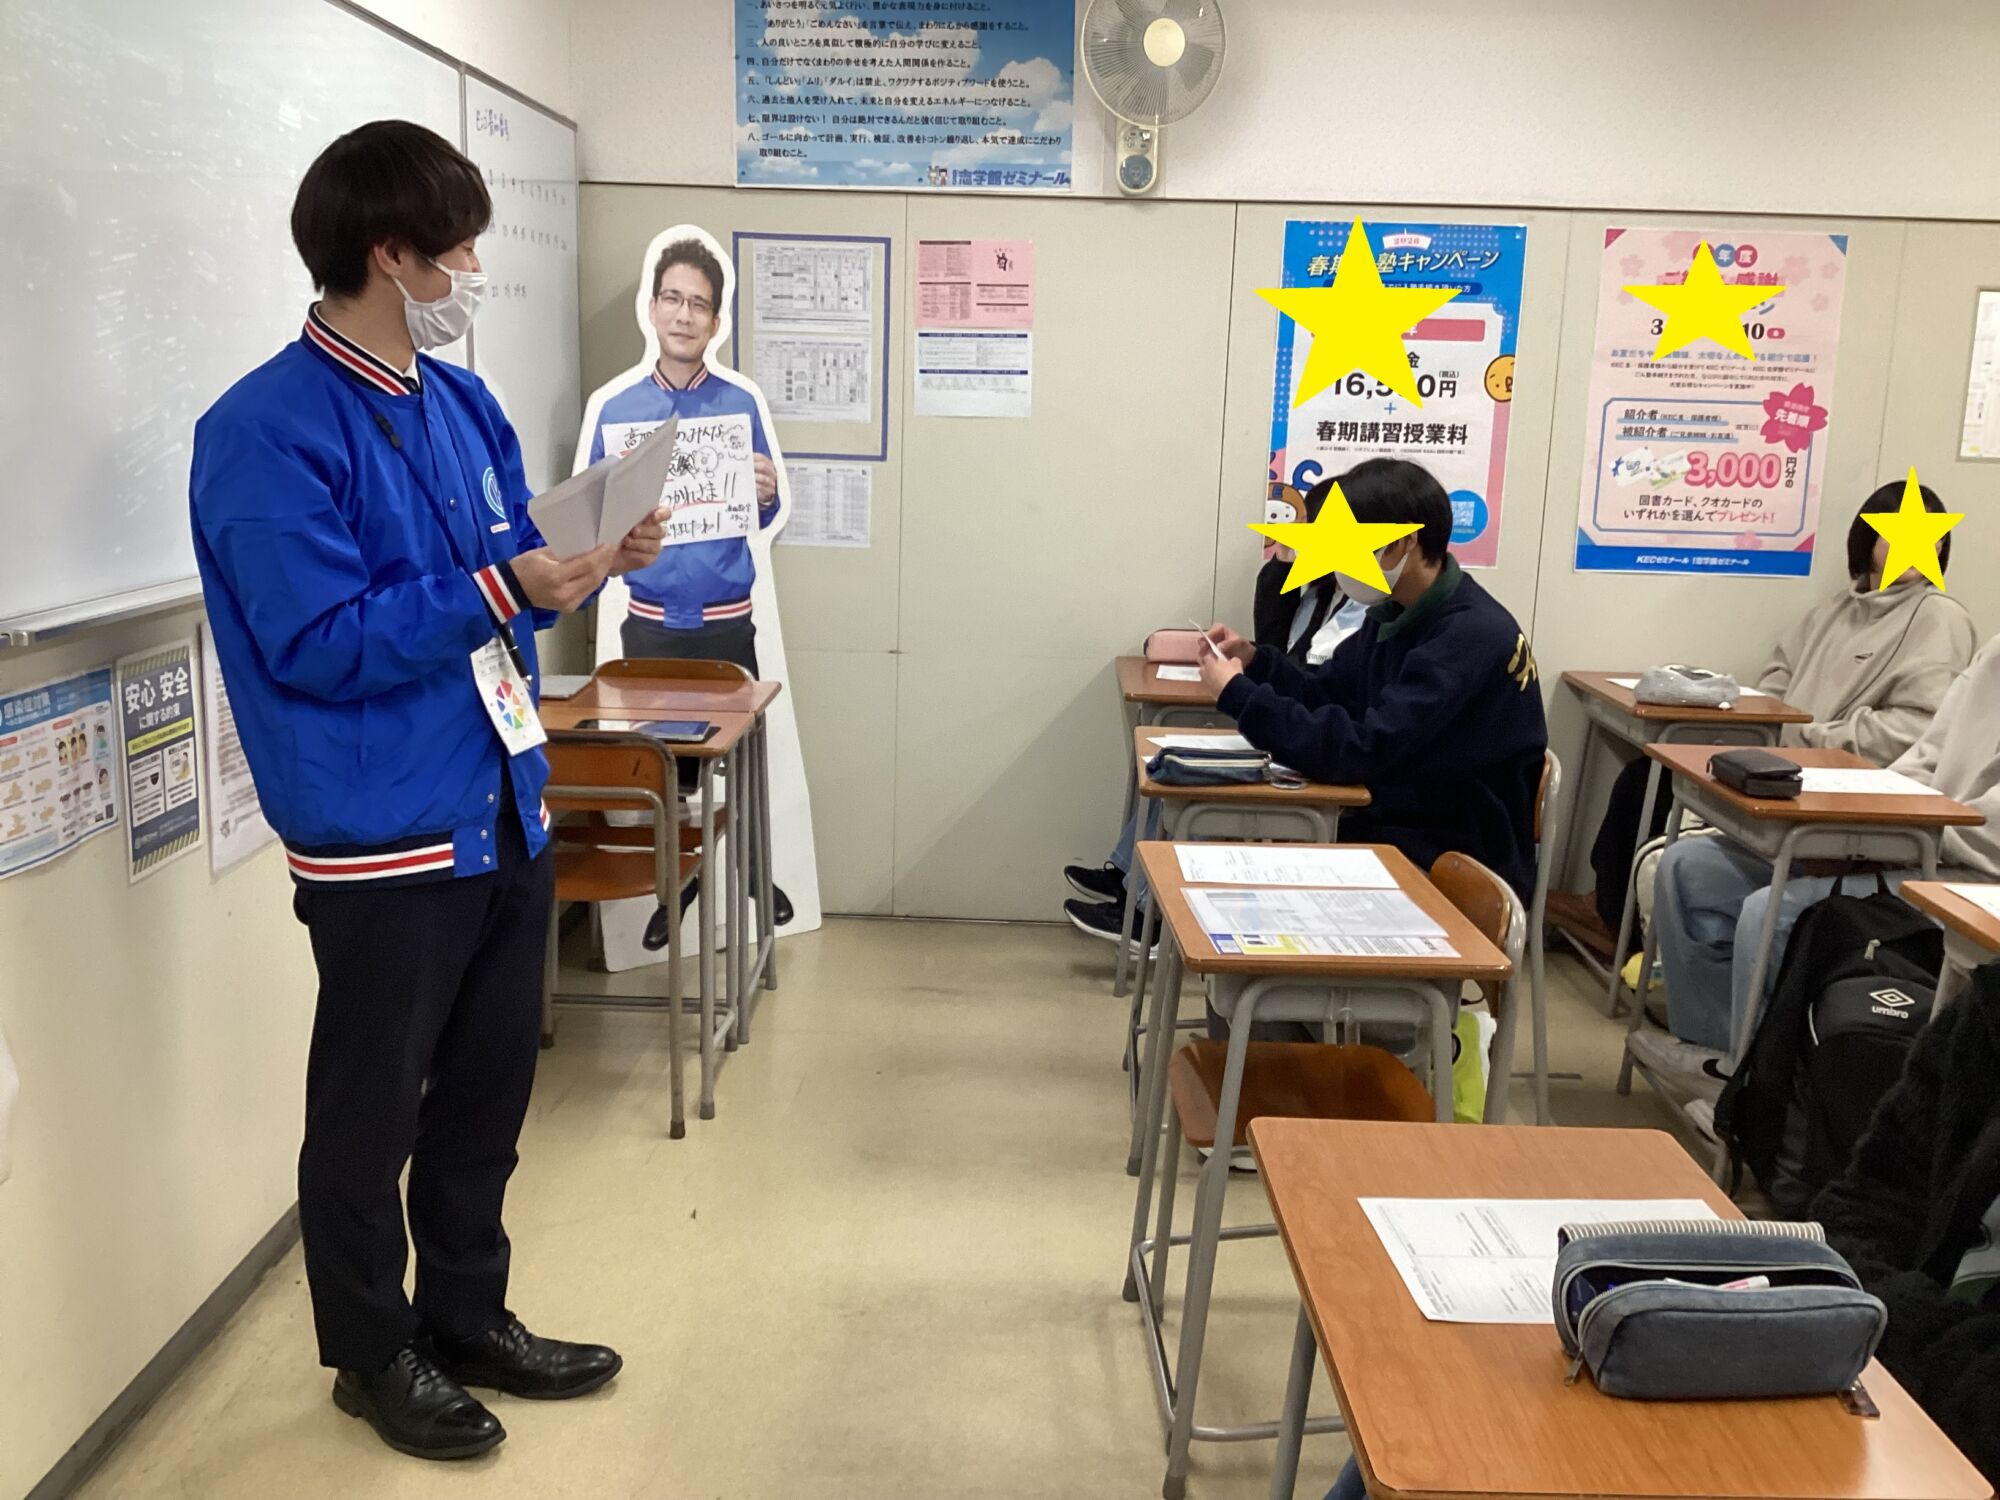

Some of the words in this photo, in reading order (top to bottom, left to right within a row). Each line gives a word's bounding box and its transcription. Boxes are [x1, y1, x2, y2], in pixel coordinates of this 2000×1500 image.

[759, 147, 808, 158] 取り組むこと。
[1307, 250, 1501, 277] 春期塾キャンペーン
[1334, 372, 1458, 400] 16,50円
[1315, 420, 1469, 446] 春期講習授業料
[1684, 450, 1782, 489] 3,000
[1784, 457, 1798, 489] 円分の
[1638, 493, 1764, 510] 図書カード、クオカードの
[125, 680, 156, 715] 安心
[160, 667, 190, 702] 安全
[1871, 1004, 1909, 1020] umbro
